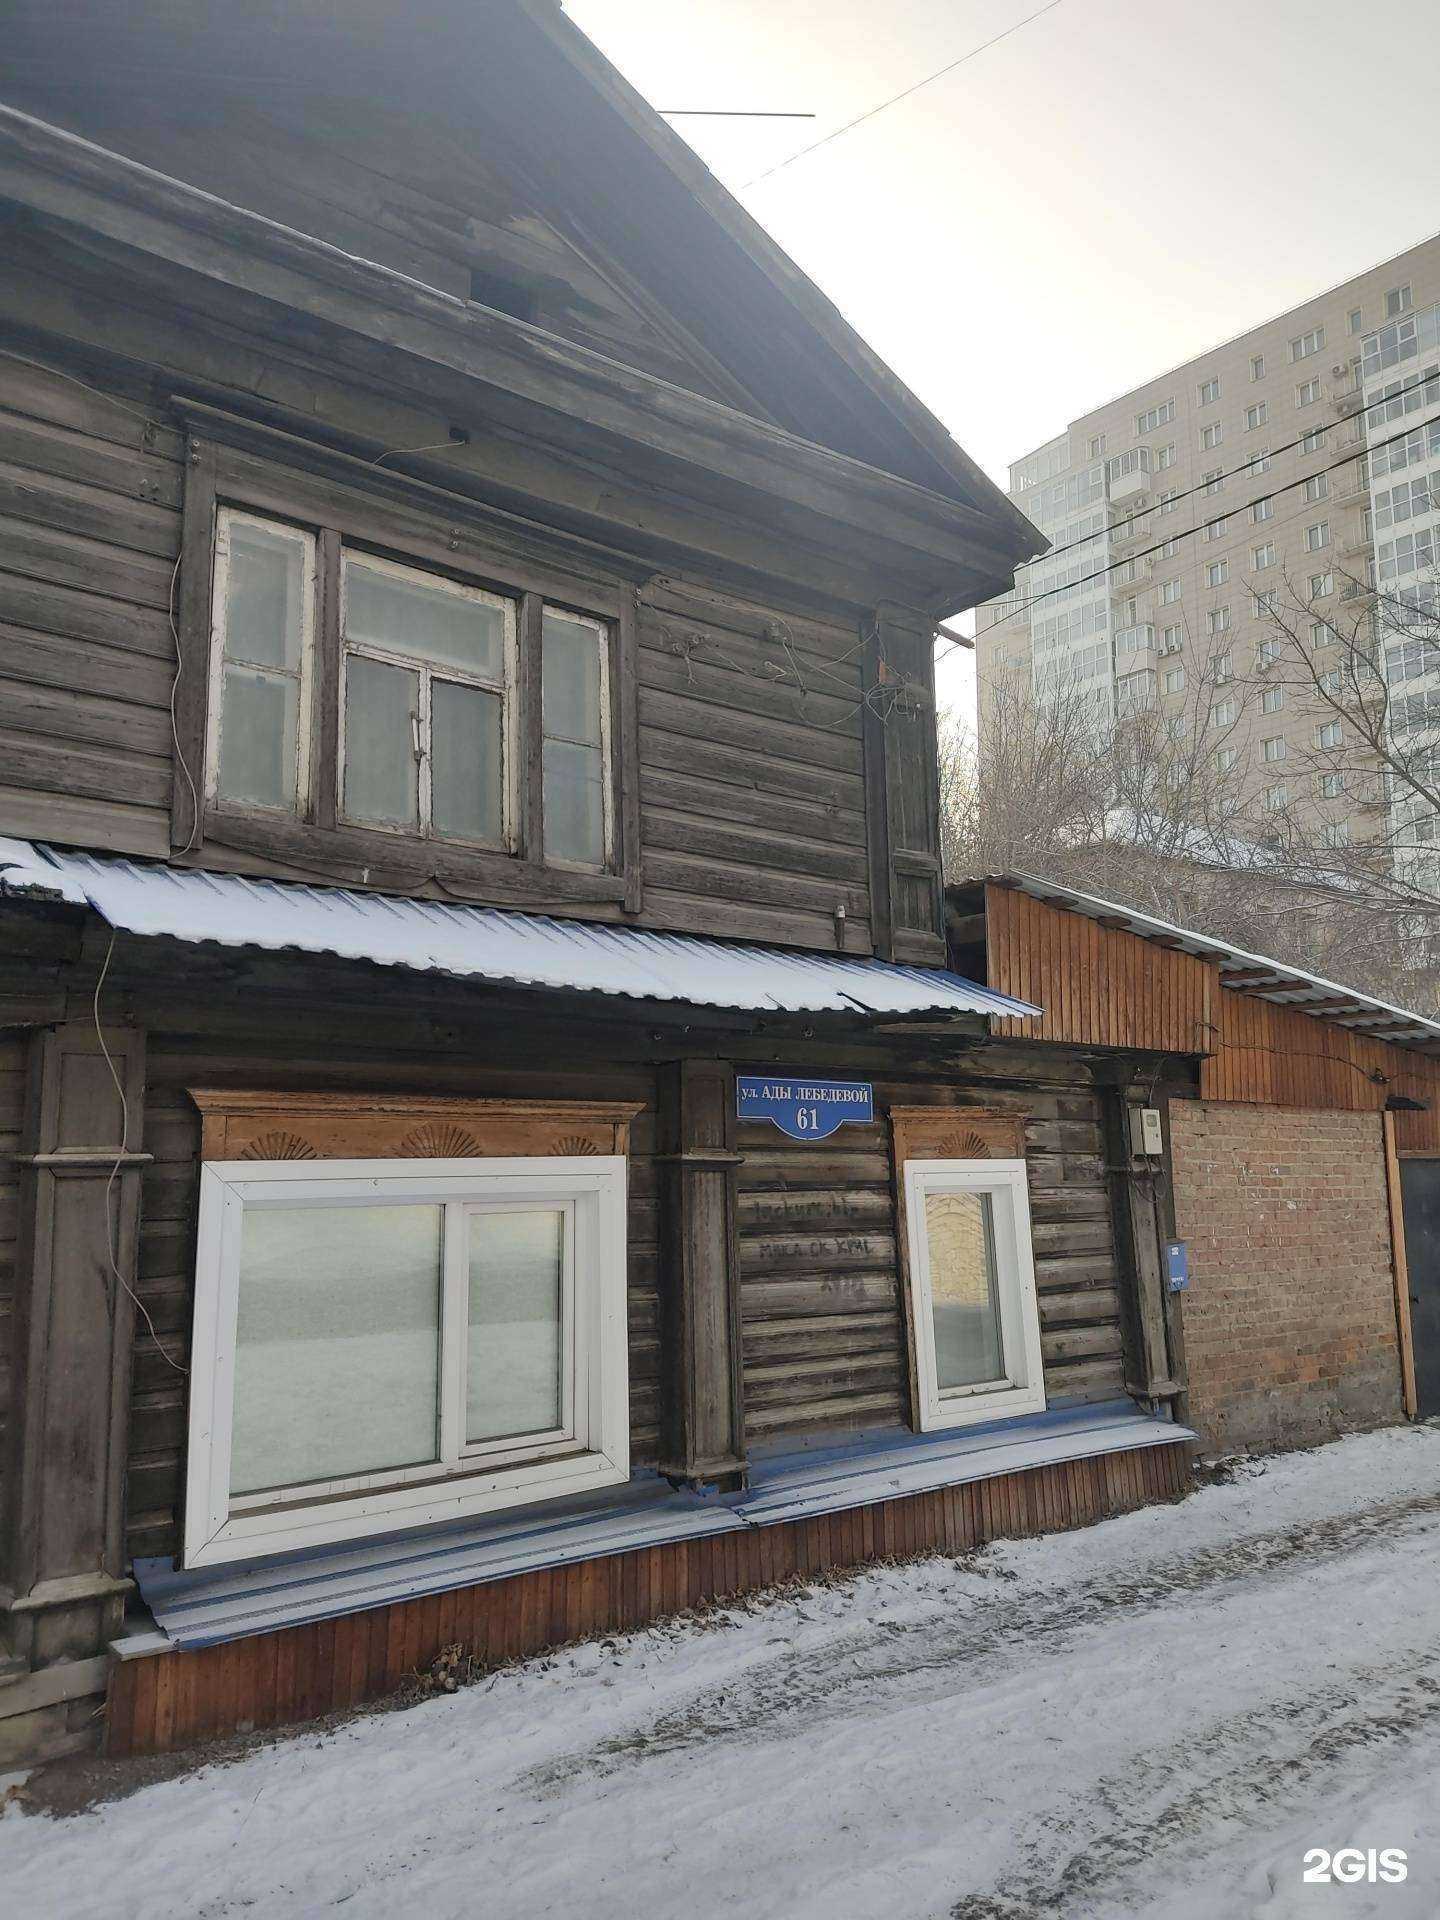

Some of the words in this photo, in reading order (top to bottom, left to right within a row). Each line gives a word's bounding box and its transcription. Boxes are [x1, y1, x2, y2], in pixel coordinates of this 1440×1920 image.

[741, 1088, 758, 1100] ул.
[761, 1086, 792, 1100] АДЫ
[796, 1087, 869, 1103] ЛЕБЕДЕВОЙ
[797, 1107, 819, 1130] 61
